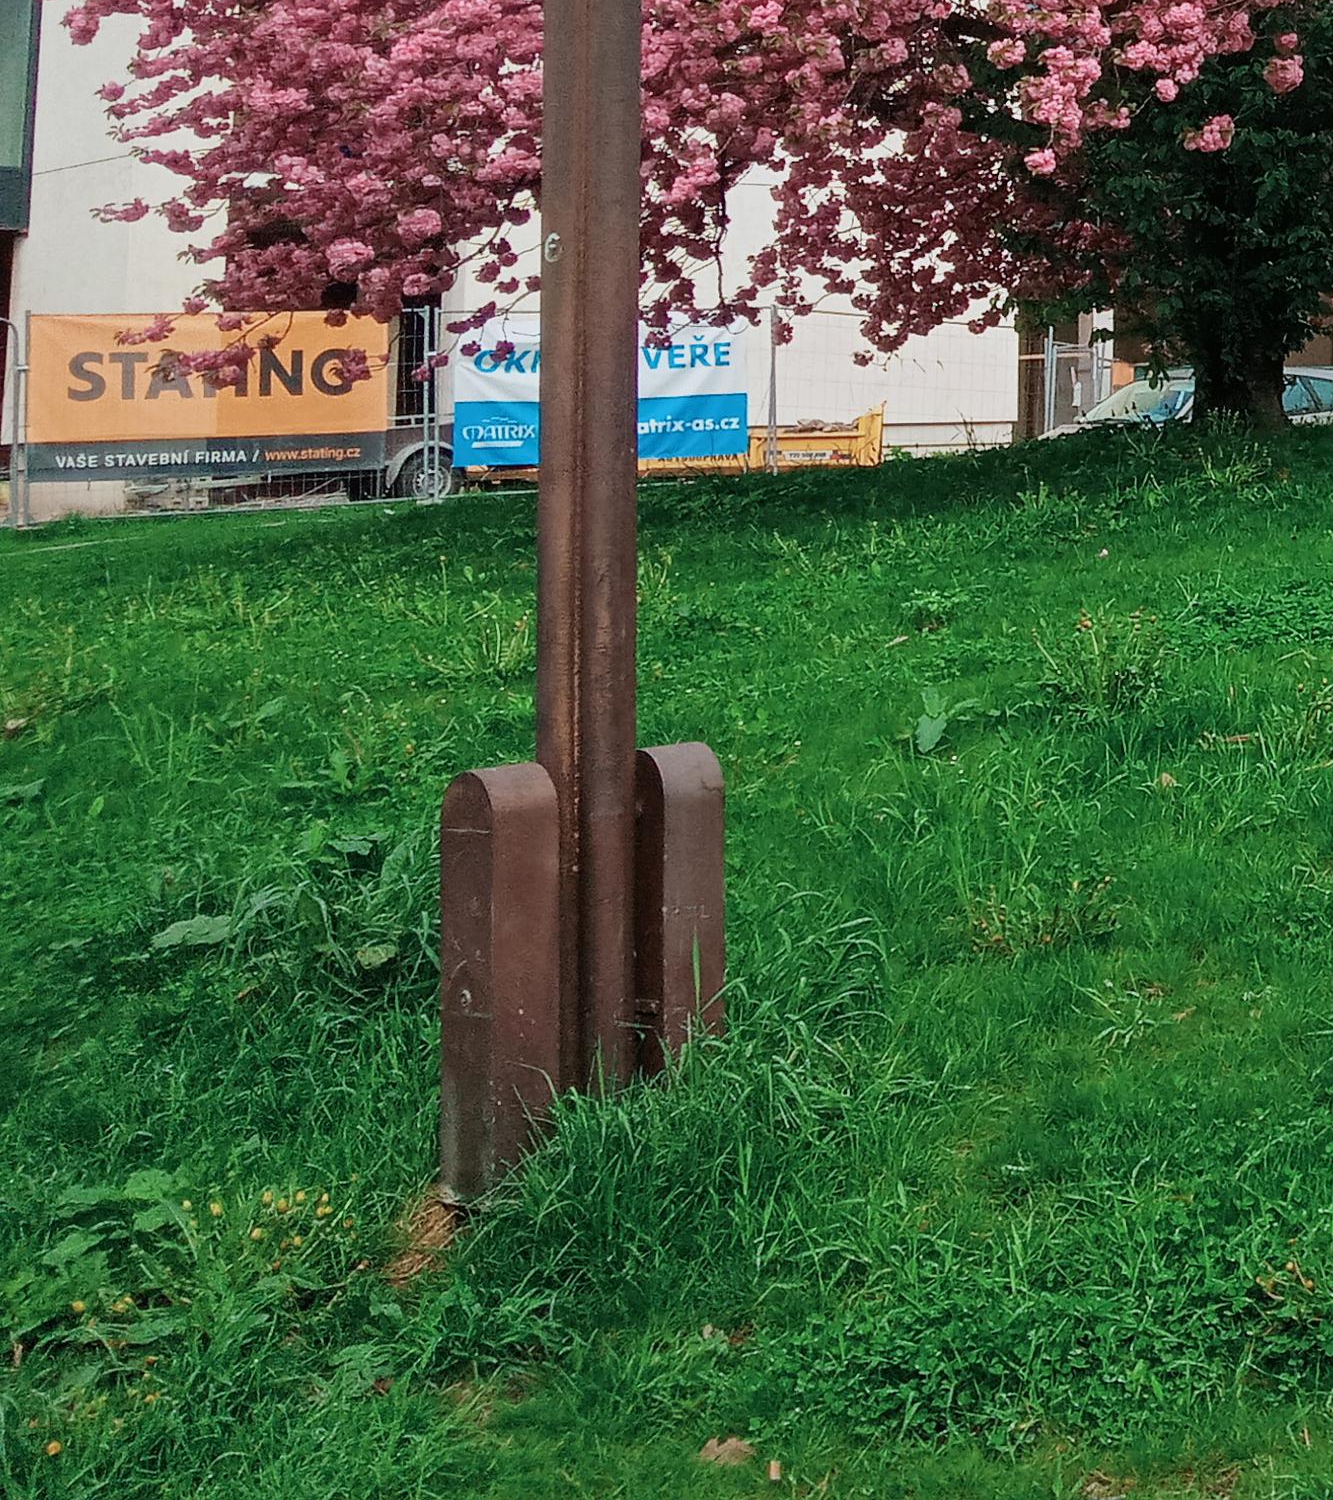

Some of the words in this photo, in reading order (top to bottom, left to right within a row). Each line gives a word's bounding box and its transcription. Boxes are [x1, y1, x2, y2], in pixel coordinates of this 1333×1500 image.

[462, 425, 535, 439] MATRIX
[55, 453, 98, 468] VAŠE
[104, 449, 190, 467] STAVEBNÍ
[195, 449, 247, 463] FIRMA
[264, 447, 361, 461] www.stating.cz
